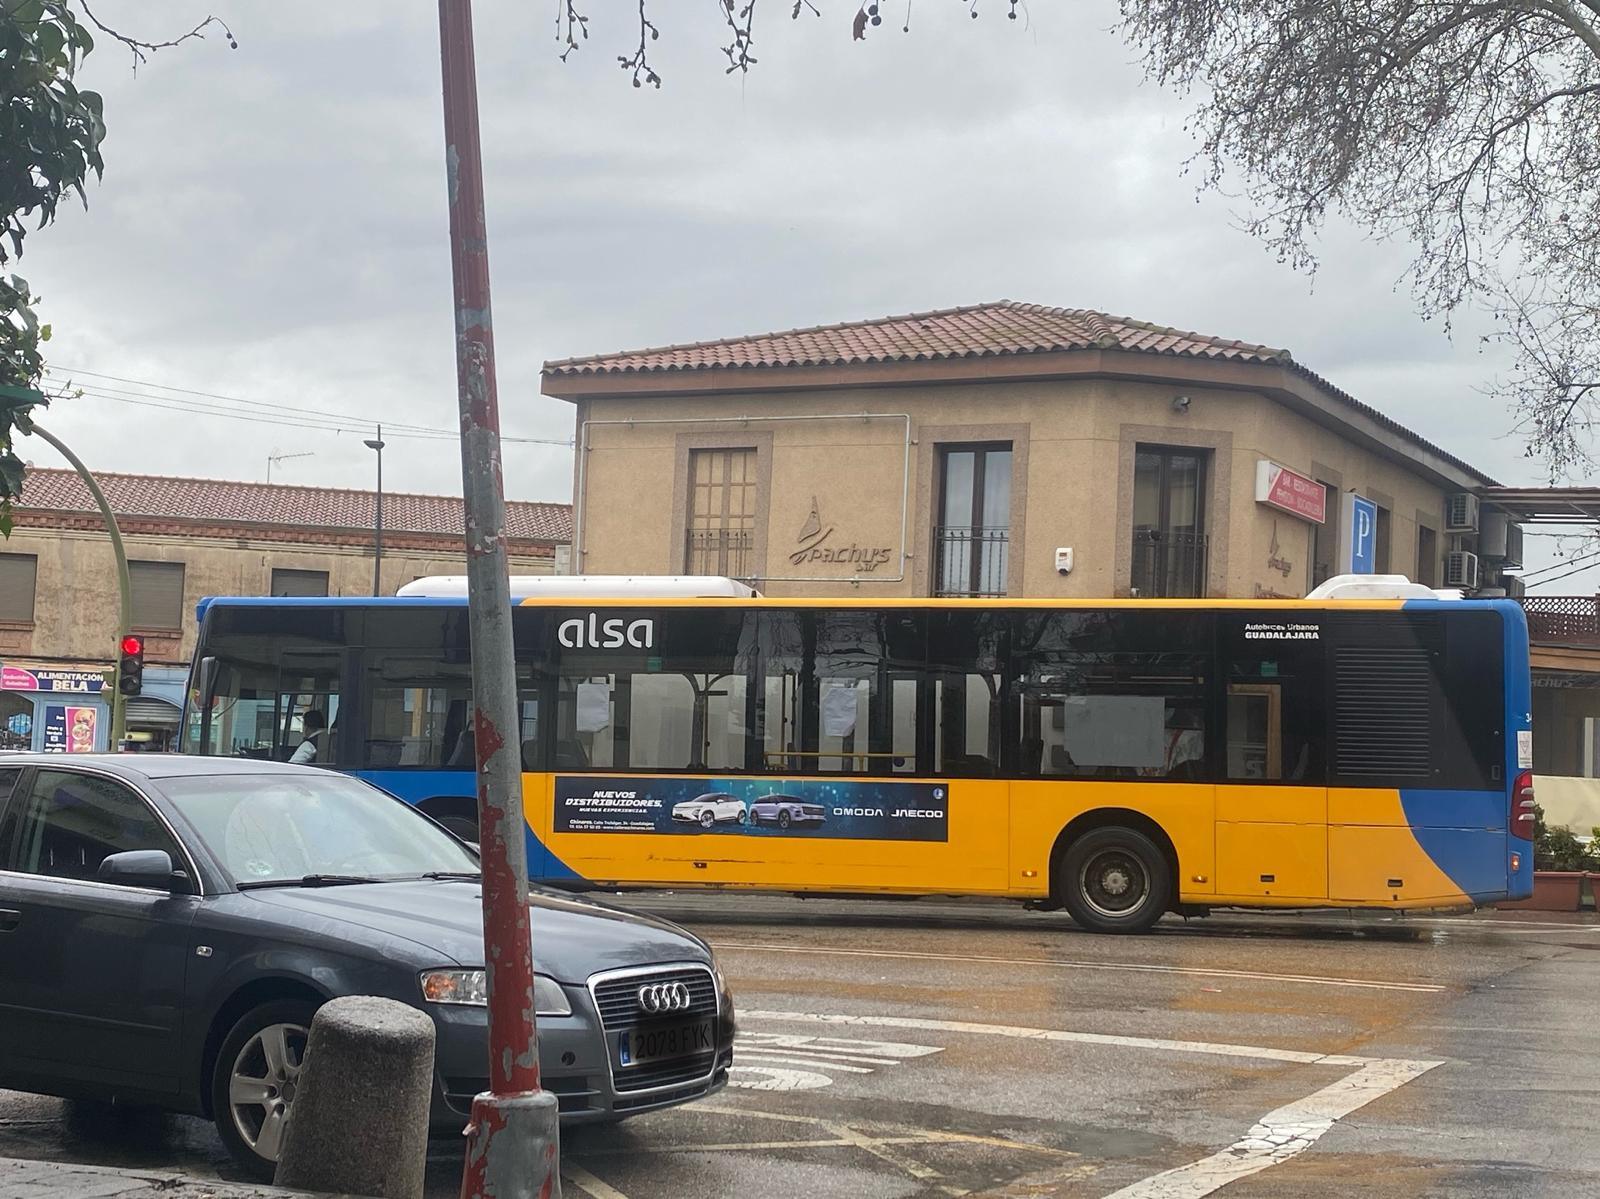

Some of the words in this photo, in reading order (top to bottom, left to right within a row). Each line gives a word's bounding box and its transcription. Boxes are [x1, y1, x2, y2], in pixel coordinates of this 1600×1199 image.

[1356, 508, 1370, 558] P
[558, 612, 653, 648] alsa
[1287, 623, 1319, 631] Urbanos
[1245, 631, 1319, 640] GUADALAJARA
[38, 672, 104, 681] ALIMENTACIÓN
[52, 680, 88, 691] BELA
[833, 807, 884, 817] OMODA
[891, 808, 944, 818] JAECOO
[635, 1030, 677, 1059] 2078
[681, 1023, 710, 1050] FYK
